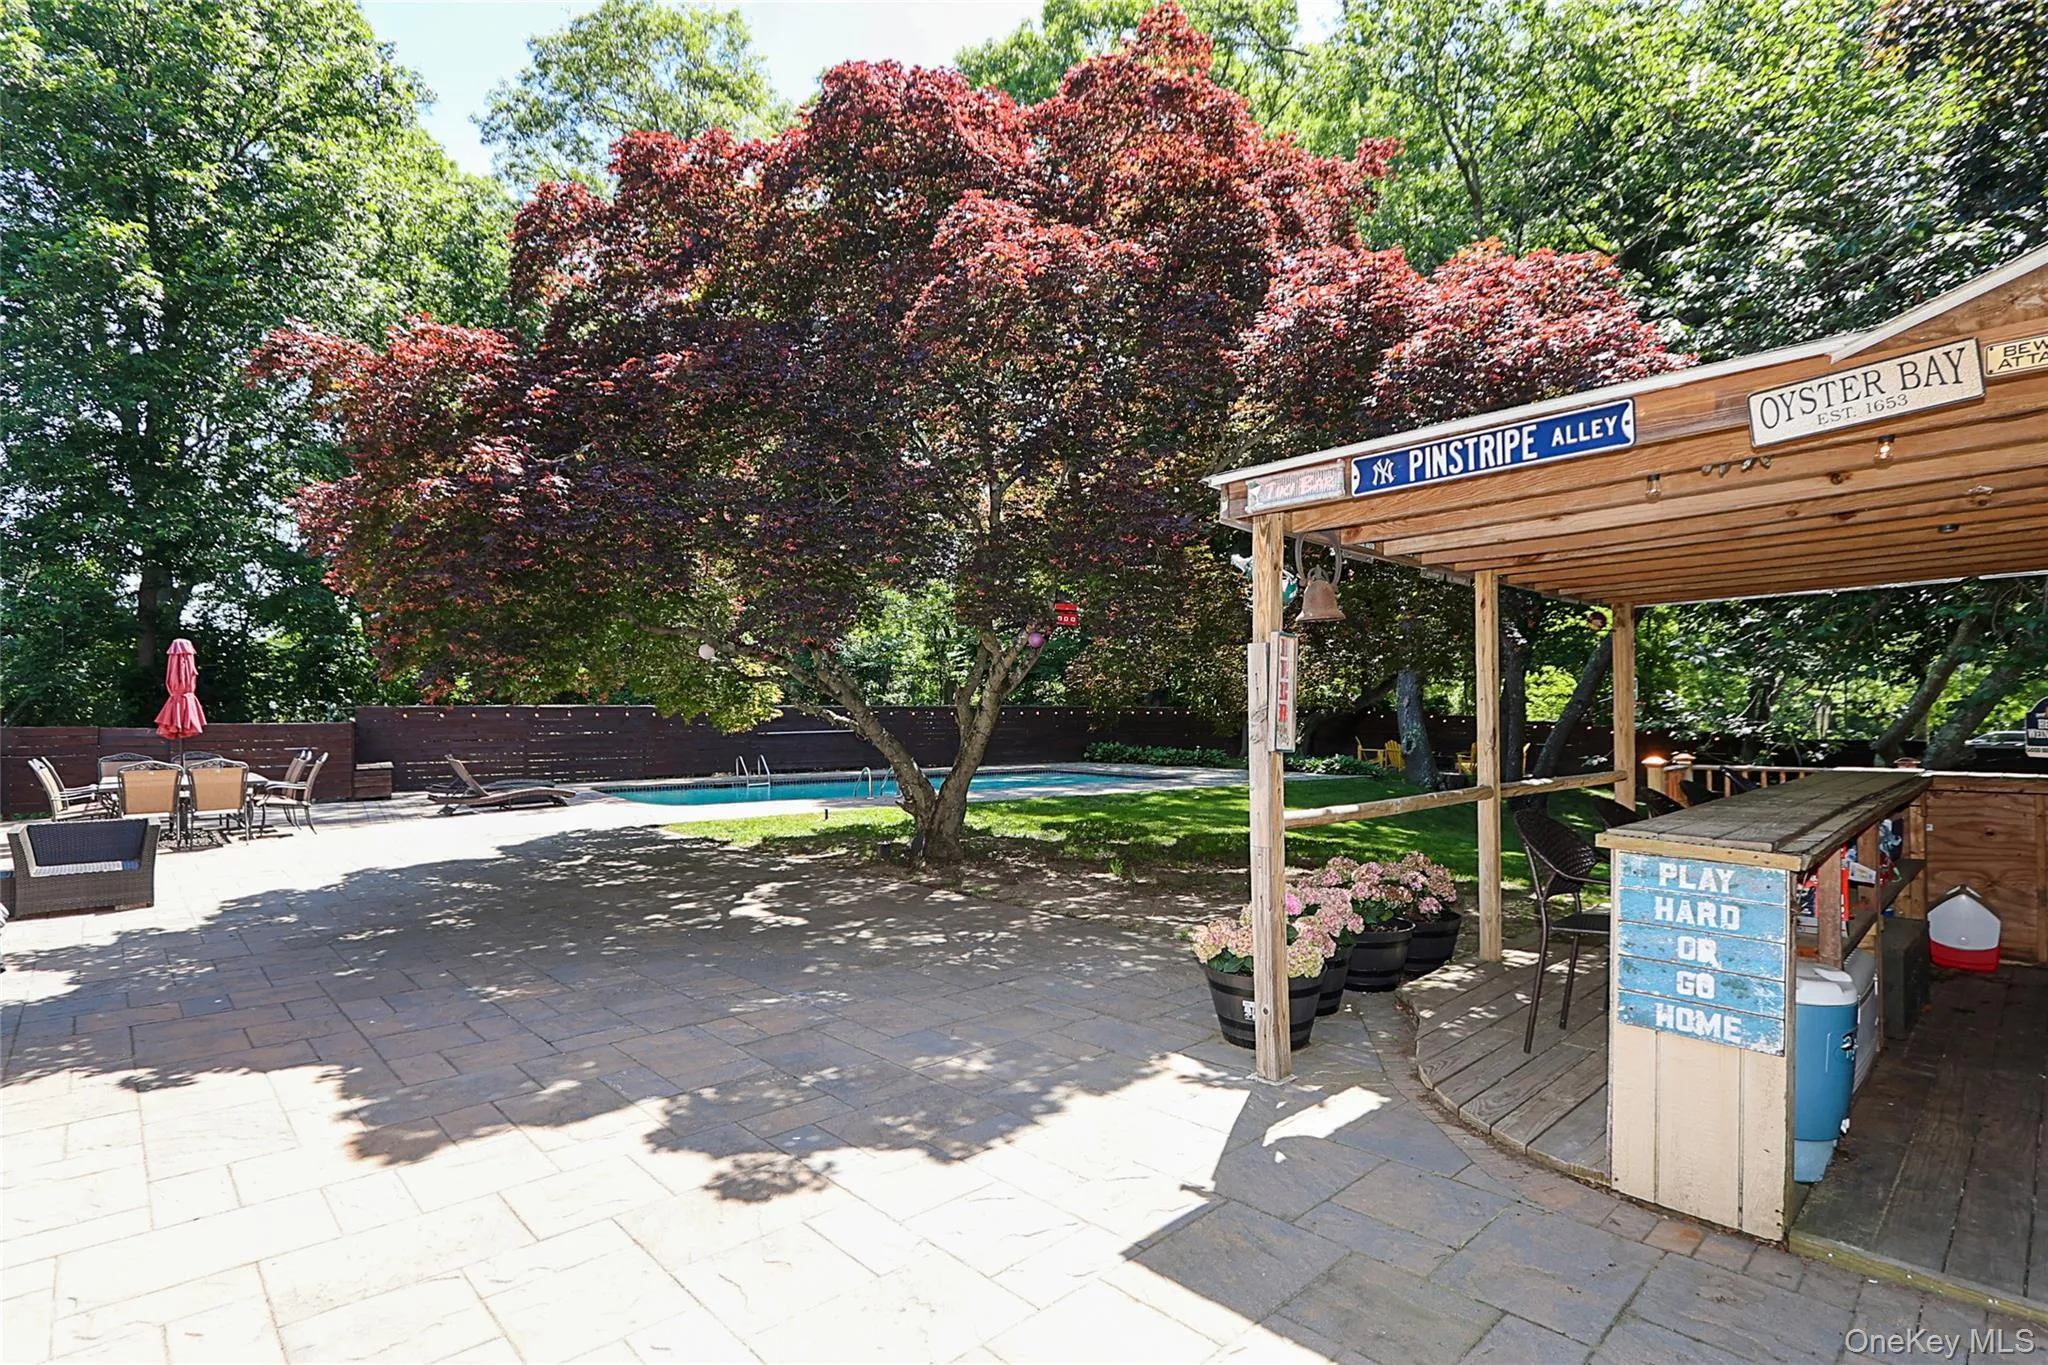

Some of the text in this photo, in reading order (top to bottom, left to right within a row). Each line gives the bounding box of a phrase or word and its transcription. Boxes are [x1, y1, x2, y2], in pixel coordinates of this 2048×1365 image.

[1760, 347, 1966, 430] OYSTER BAY
[1818, 395, 1909, 426] EST. 1653
[1409, 424, 1538, 482] PINSTRIPE
[1551, 416, 1618, 447] ALLEY
[1659, 862, 1736, 894] PLAY
[1654, 896, 1741, 931] HARD
[1677, 936, 1721, 970] OR
[1676, 970, 1715, 999] GO
[1655, 1003, 1743, 1044] HOME
